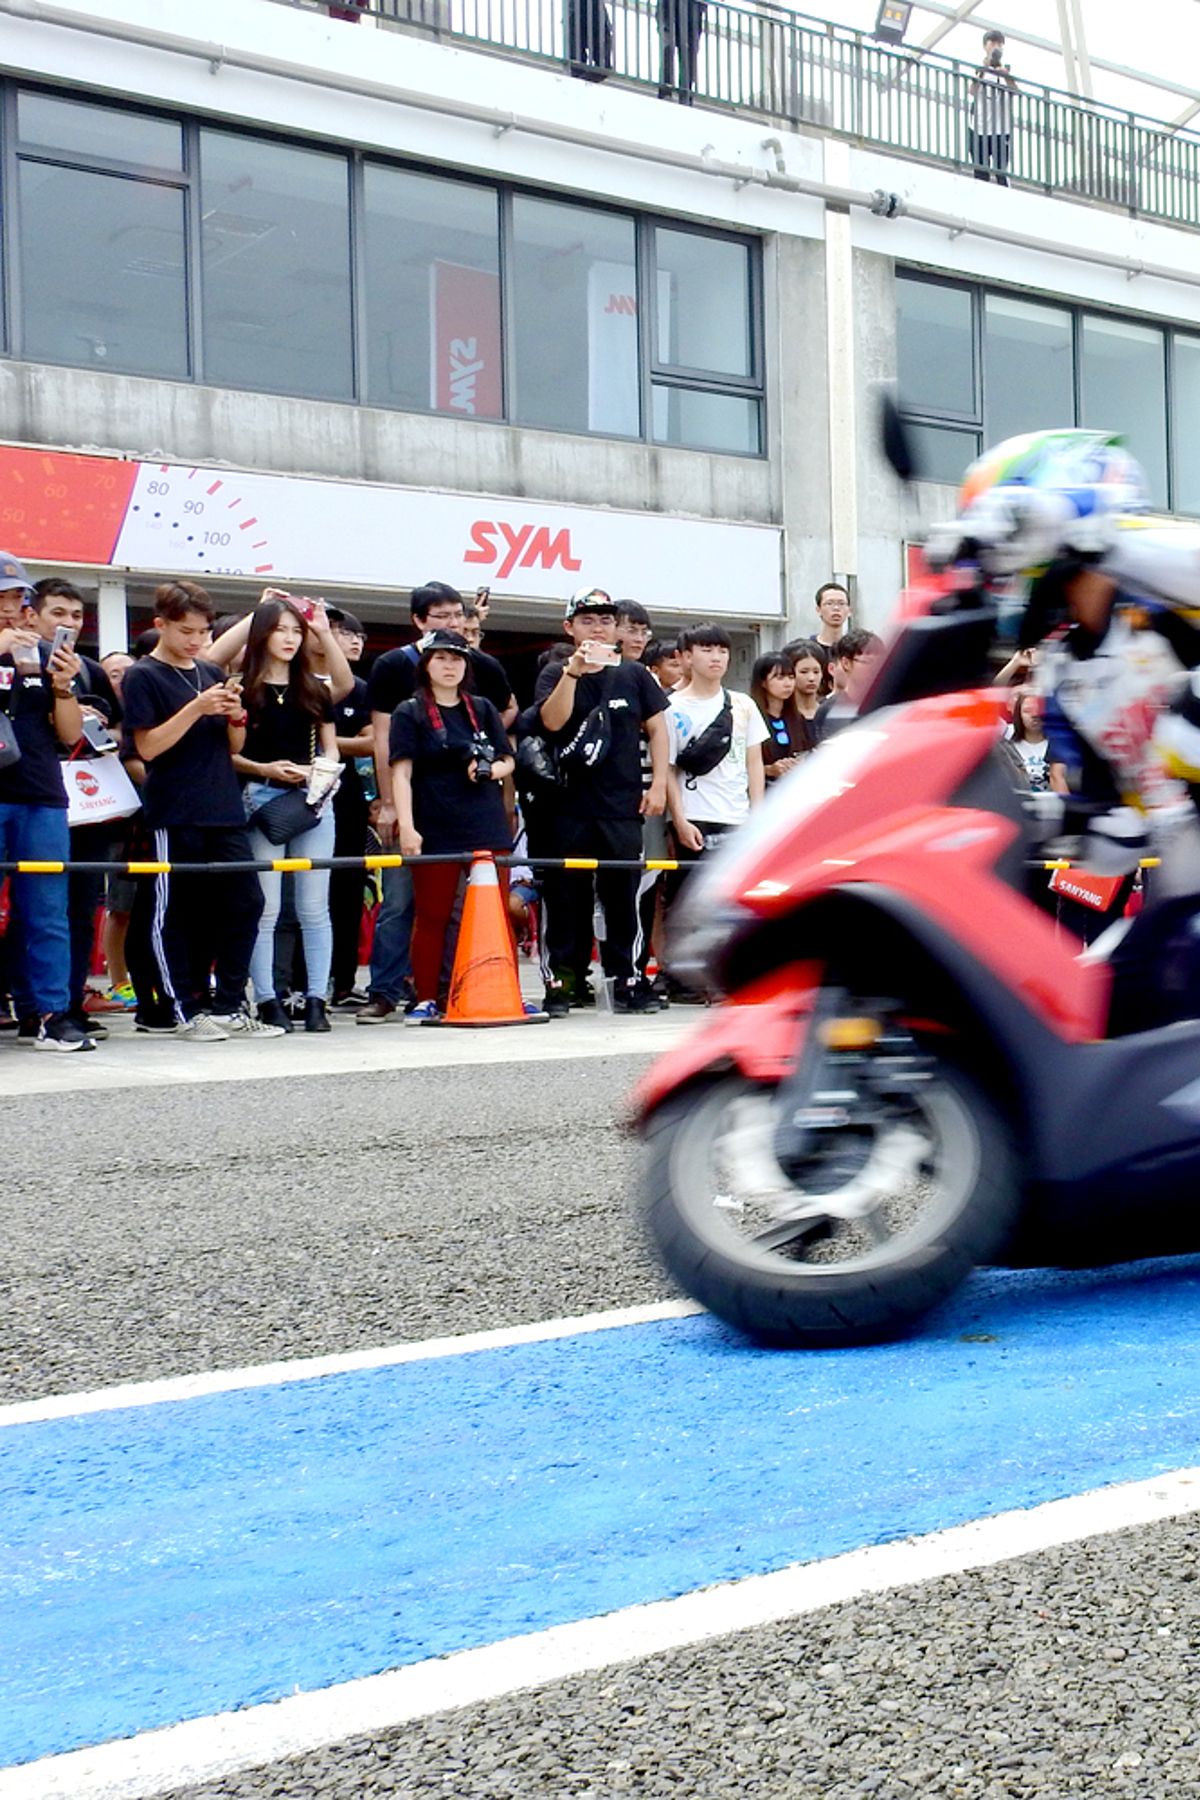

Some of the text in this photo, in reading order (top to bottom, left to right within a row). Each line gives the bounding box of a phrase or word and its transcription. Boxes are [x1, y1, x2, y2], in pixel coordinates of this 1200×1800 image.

[44, 483, 67, 498] 60
[147, 481, 170, 496] 80
[183, 500, 205, 515] 90
[203, 531, 231, 547] 100
[463, 520, 582, 578] SYM
[1059, 880, 1103, 906] SANYANG
